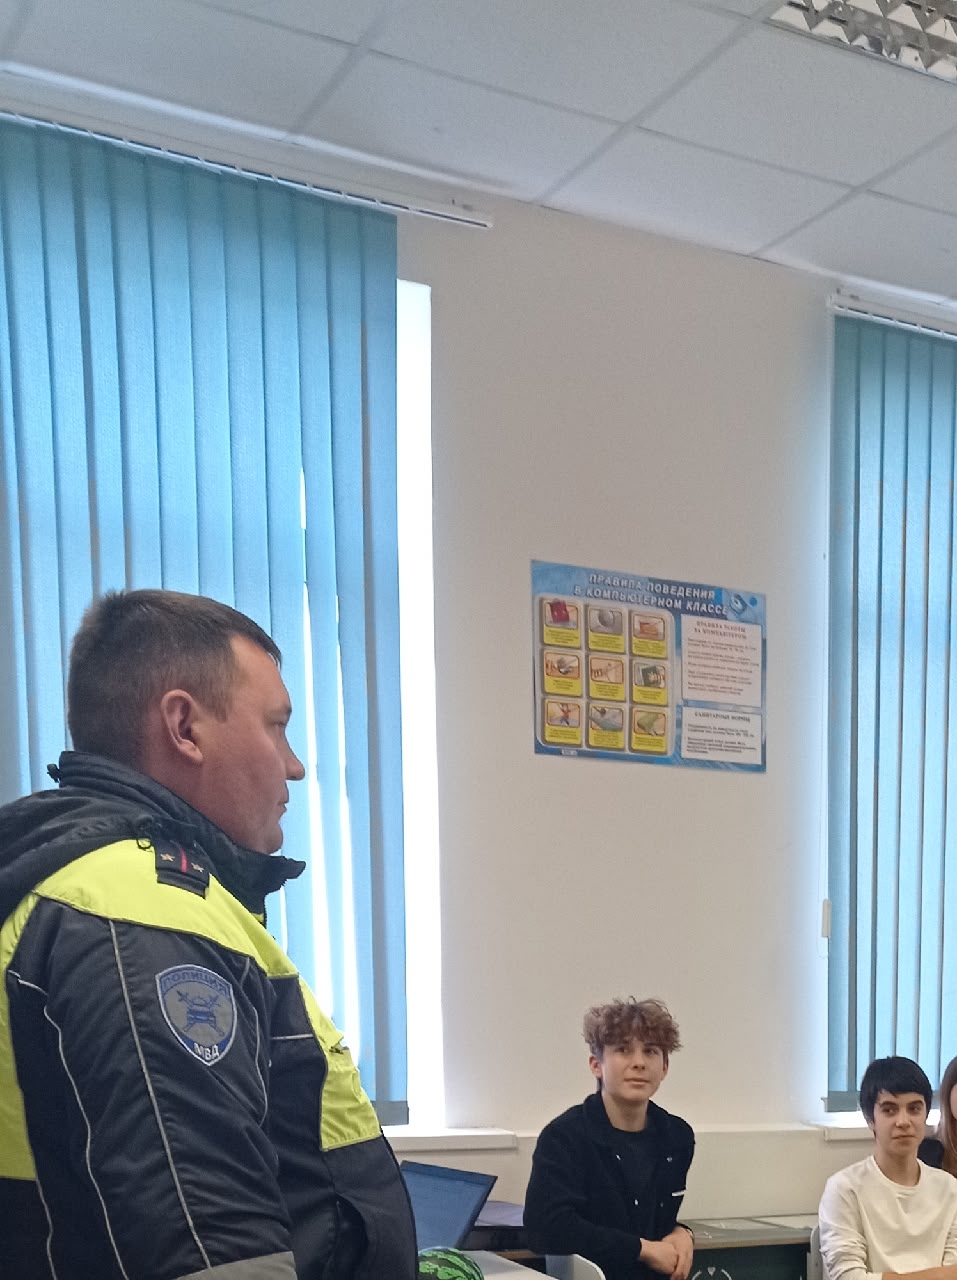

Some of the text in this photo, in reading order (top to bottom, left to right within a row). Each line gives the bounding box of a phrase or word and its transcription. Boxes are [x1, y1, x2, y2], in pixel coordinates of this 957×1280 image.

[589, 574, 715, 600] ПРАВИЛА ПОВЕДЕНИЯ
[573, 585, 729, 616] В КОМПЬЮТЕРНОМ КЛАССЕ
[161, 971, 229, 998] ПОЛИЦИЯ
[193, 1042, 220, 1061] МВД
